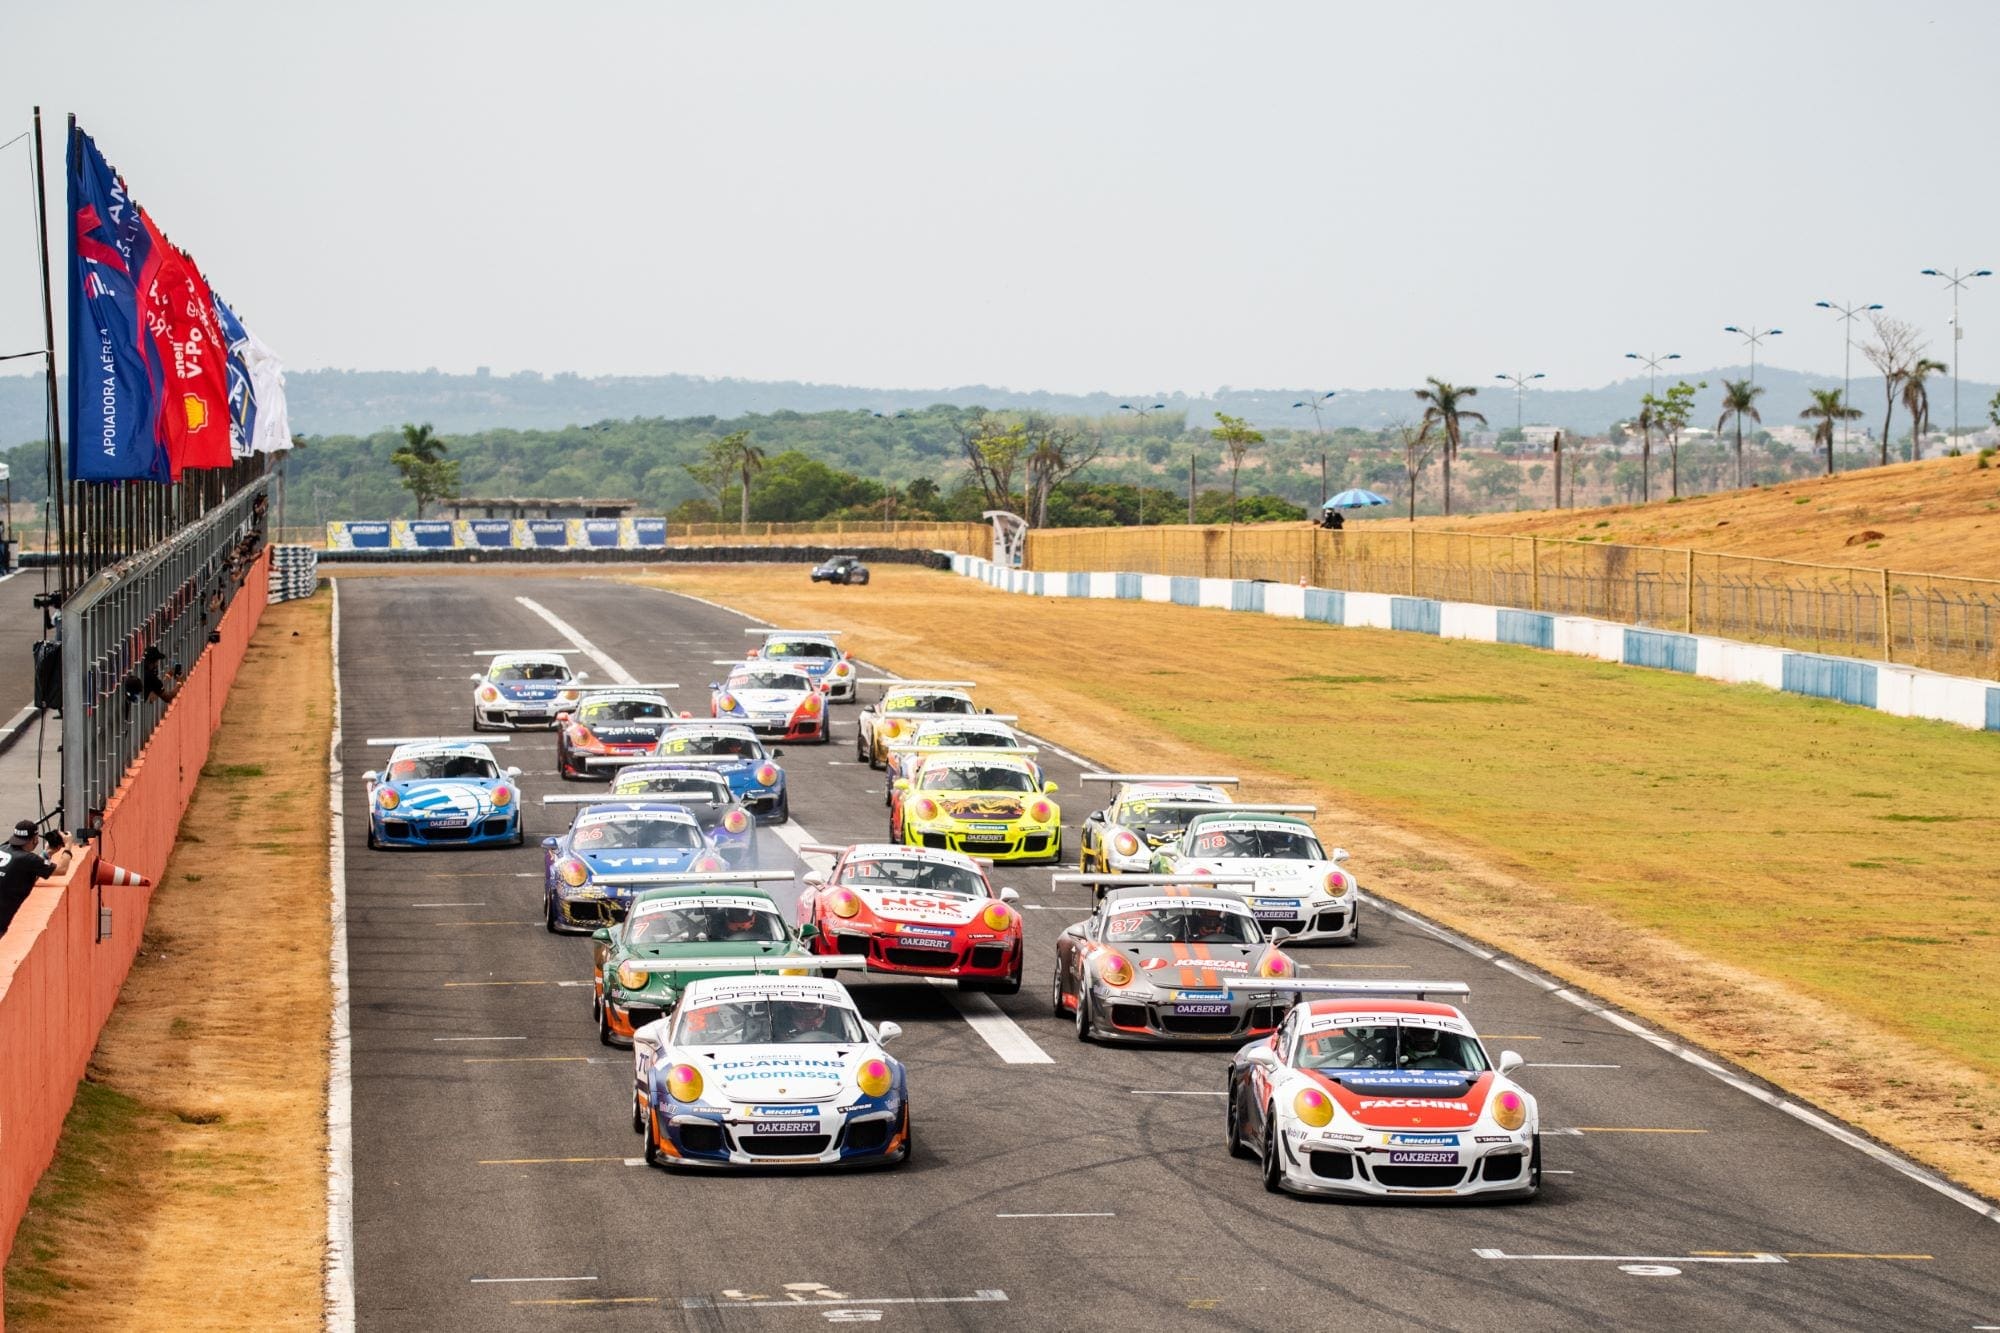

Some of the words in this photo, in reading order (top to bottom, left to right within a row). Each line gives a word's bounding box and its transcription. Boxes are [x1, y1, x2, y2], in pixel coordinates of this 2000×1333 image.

[103, 377, 116, 456] APOIADORA
[1200, 835, 1227, 849] 18
[602, 857, 679, 867] YPF
[848, 864, 871, 878] 11
[642, 899, 769, 912] PORSCHE
[882, 898, 962, 913] NGK
[1118, 899, 1241, 910] PORSCHE
[632, 922, 650, 938] 7
[1110, 917, 1144, 934] 87
[900, 937, 950, 948] OAKBERRY
[1174, 959, 1249, 970] JOSECAR
[694, 990, 841, 1005] PORSCHE
[1177, 1005, 1228, 1013] OAKBERRY
[1311, 1016, 1464, 1031] PORSCHE
[709, 1060, 846, 1070] TOCANTINS
[724, 1070, 841, 1081] votomassa
[1350, 1077, 1461, 1086] BRASPRESS
[764, 1107, 814, 1115] MICHELIN
[1360, 1099, 1469, 1112] FACCHINI
[756, 1122, 817, 1133] OAKBERRY
[1404, 1136, 1454, 1145] MICHELIN
[1393, 1152, 1456, 1163] OAKBERRY
